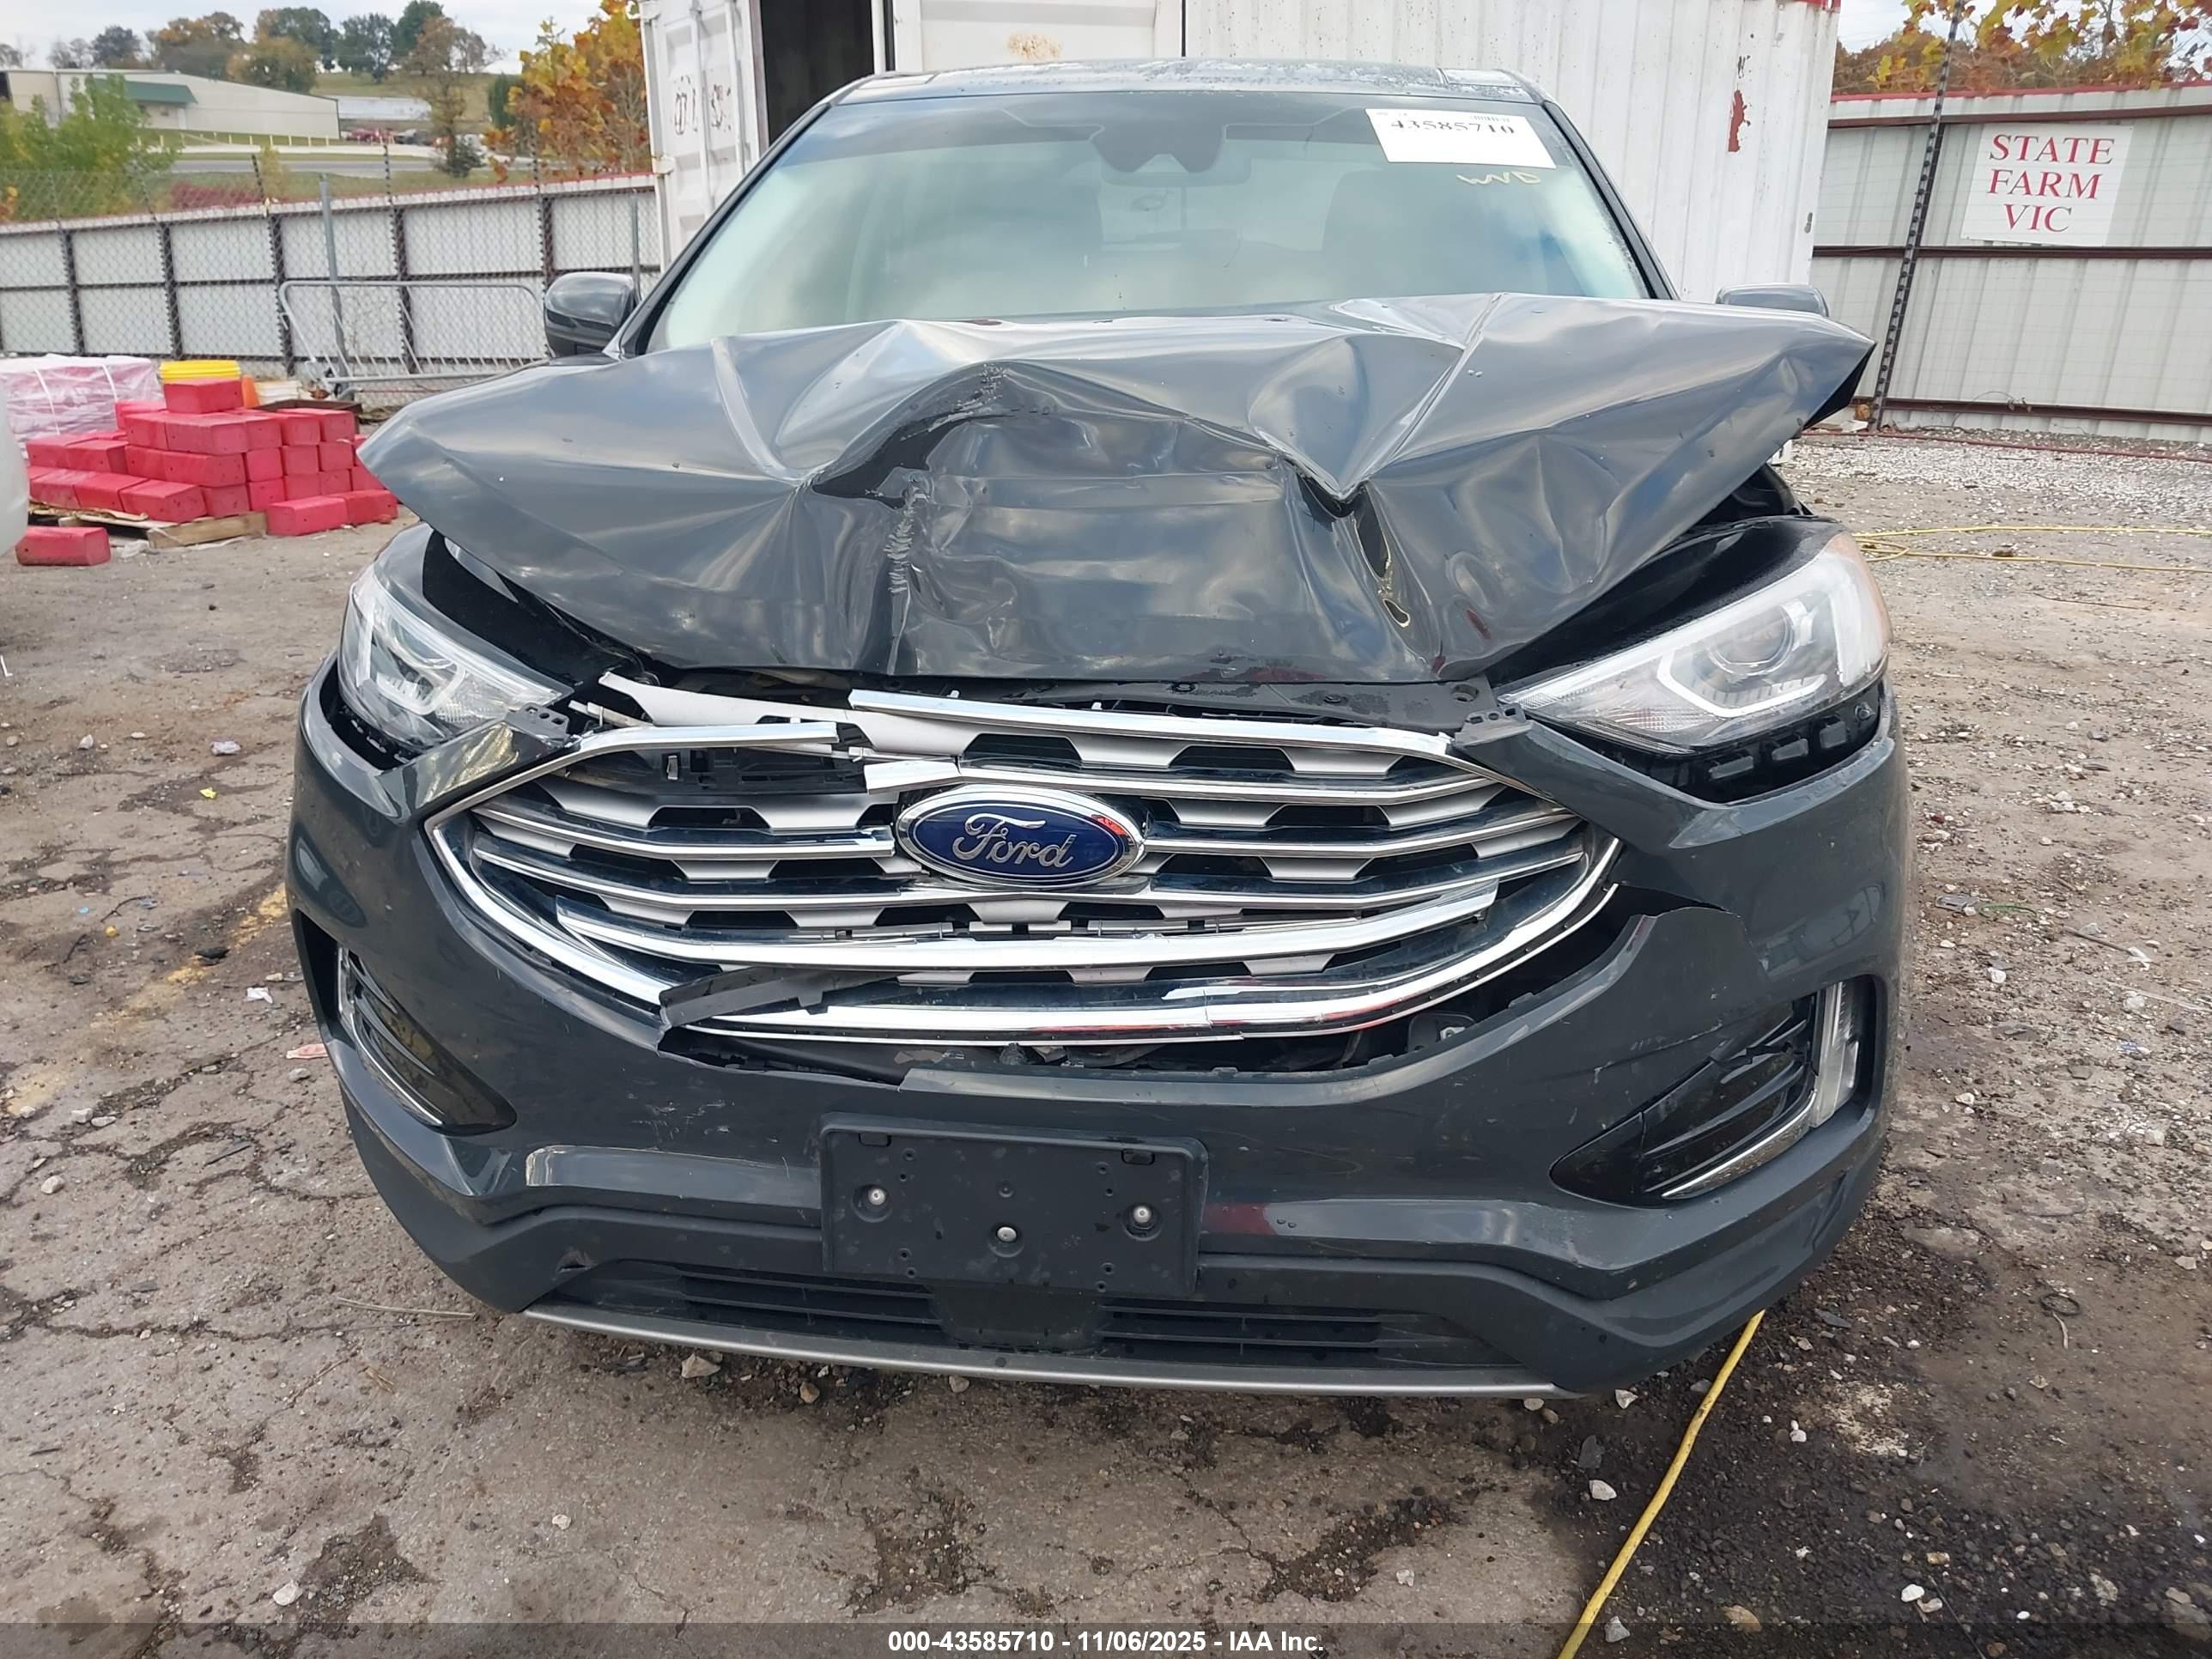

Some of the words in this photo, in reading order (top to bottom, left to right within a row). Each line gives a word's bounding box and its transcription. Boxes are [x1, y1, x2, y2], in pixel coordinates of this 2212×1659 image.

[1989, 133, 2115, 165] STATE
[1986, 168, 2103, 200] FARM
[2003, 203, 2073, 233] VIC
[951, 812, 1078, 868] Ford
